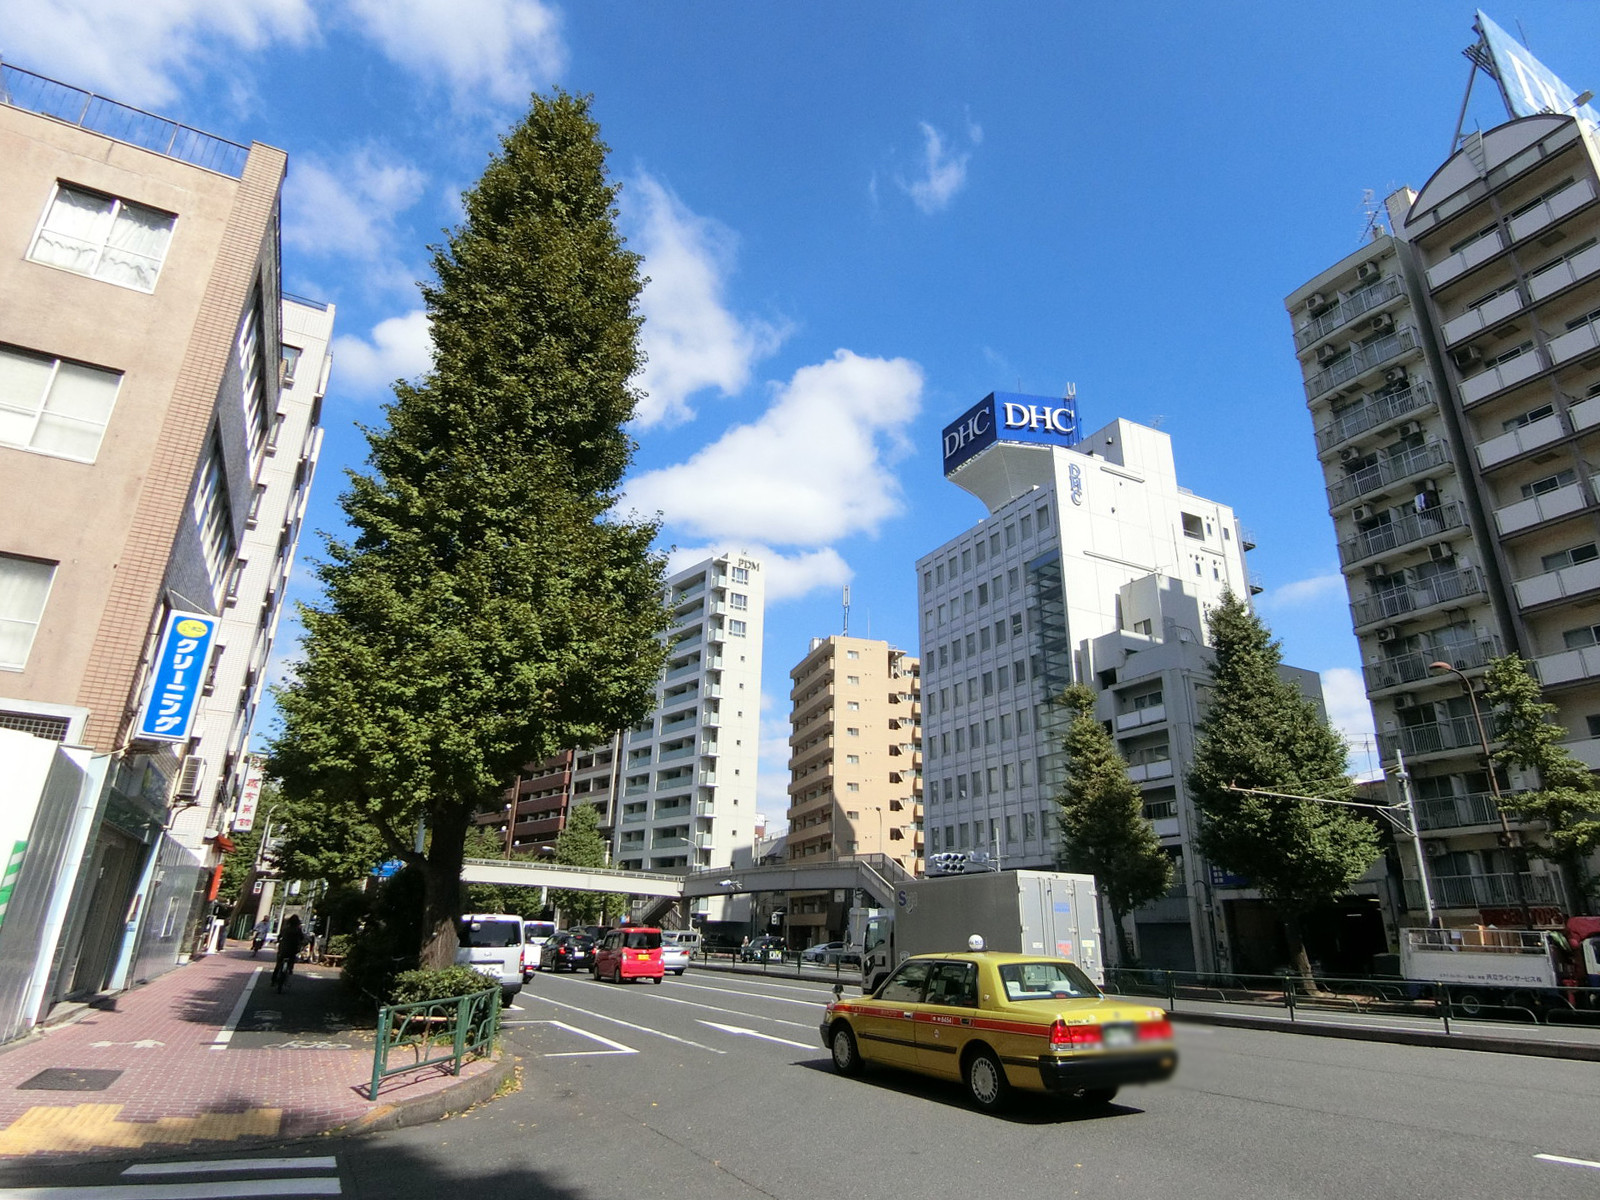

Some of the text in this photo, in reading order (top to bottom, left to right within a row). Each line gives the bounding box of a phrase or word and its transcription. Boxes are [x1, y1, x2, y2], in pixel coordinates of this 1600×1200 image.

[944, 405, 990, 459] DHC
[1004, 402, 1076, 432] DHC
[1068, 462, 1083, 506] DHC
[154, 638, 199, 732] クリーニング
